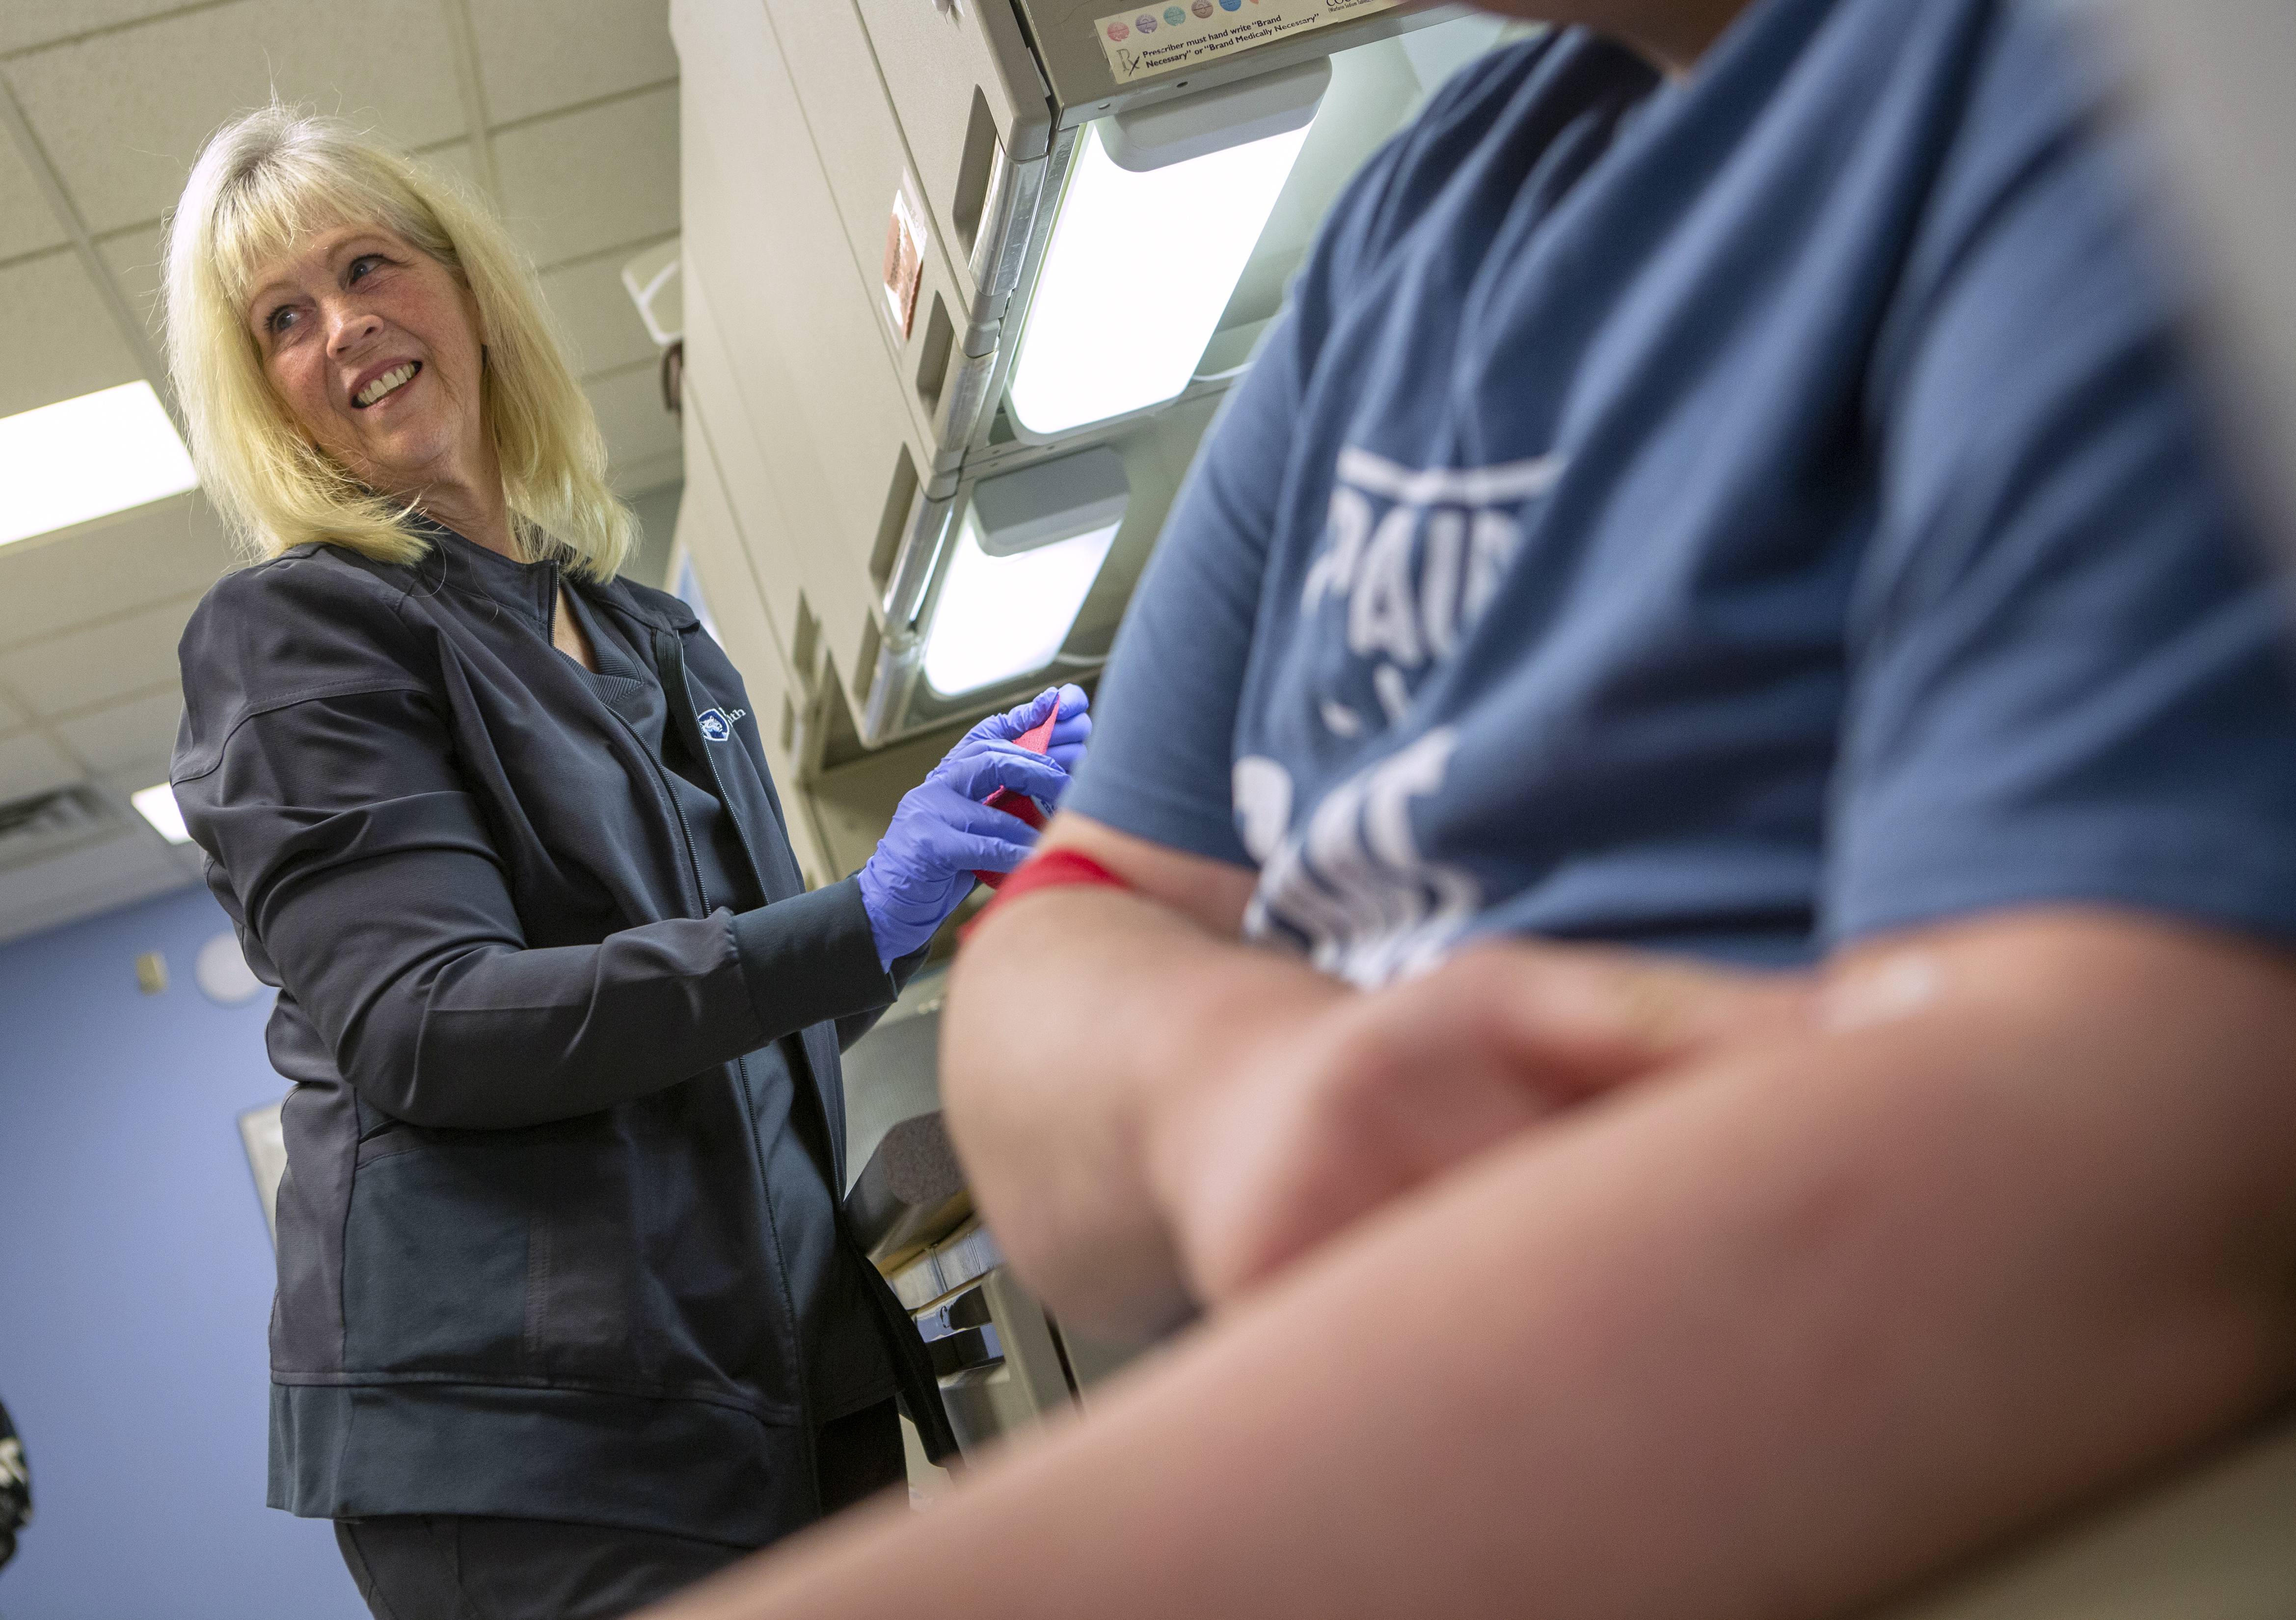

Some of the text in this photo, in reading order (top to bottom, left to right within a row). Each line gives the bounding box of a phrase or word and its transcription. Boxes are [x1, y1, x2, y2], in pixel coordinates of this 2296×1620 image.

[1142, 15, 1282, 58] Prescriber must hand write “Brand
[1146, 50, 1191, 68] Necessary”
[1204, 39, 1234, 51] “Brand
[1235, 28, 1272, 43] Medically
[1274, 13, 1319, 32] Necessary”
